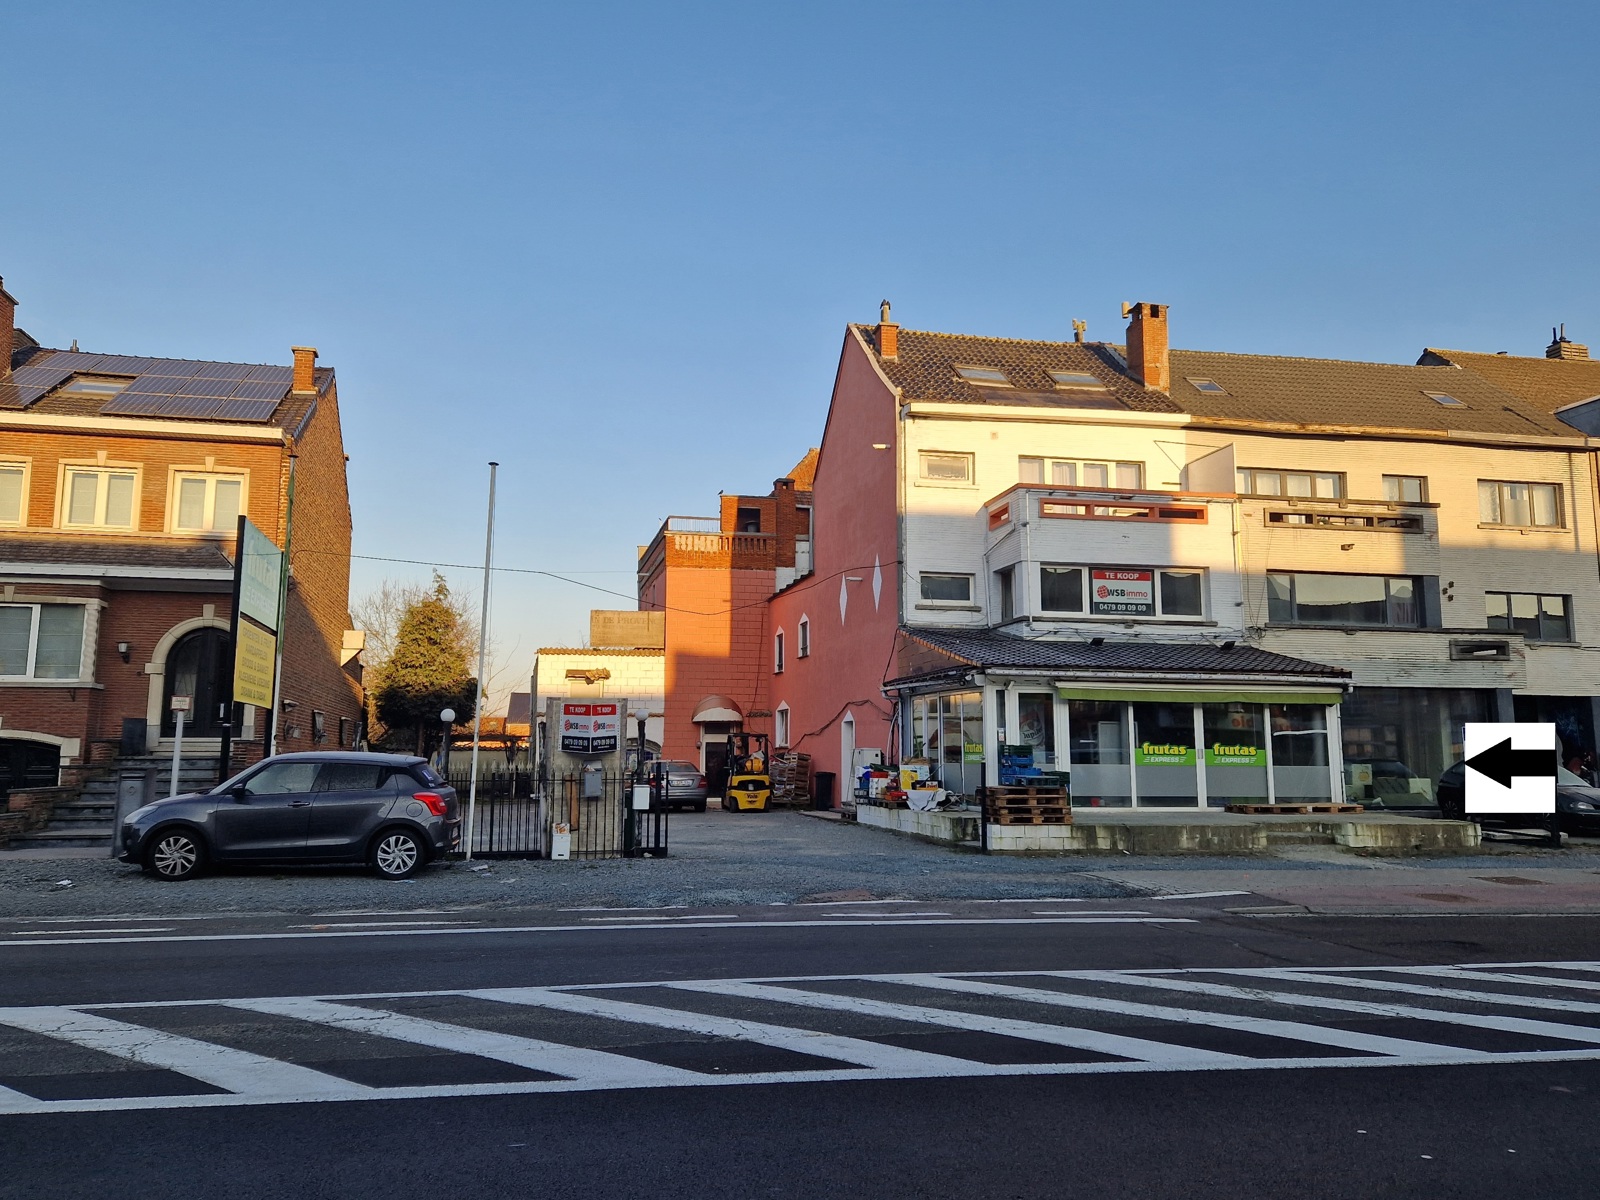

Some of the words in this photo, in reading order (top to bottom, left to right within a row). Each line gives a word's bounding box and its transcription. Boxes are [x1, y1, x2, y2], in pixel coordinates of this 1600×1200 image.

[575, 706, 587, 714] KOOP
[602, 706, 612, 714] KOOP
[964, 741, 983, 753] frutas
[1143, 742, 1188, 755] frutas
[1213, 742, 1258, 756] frutas
